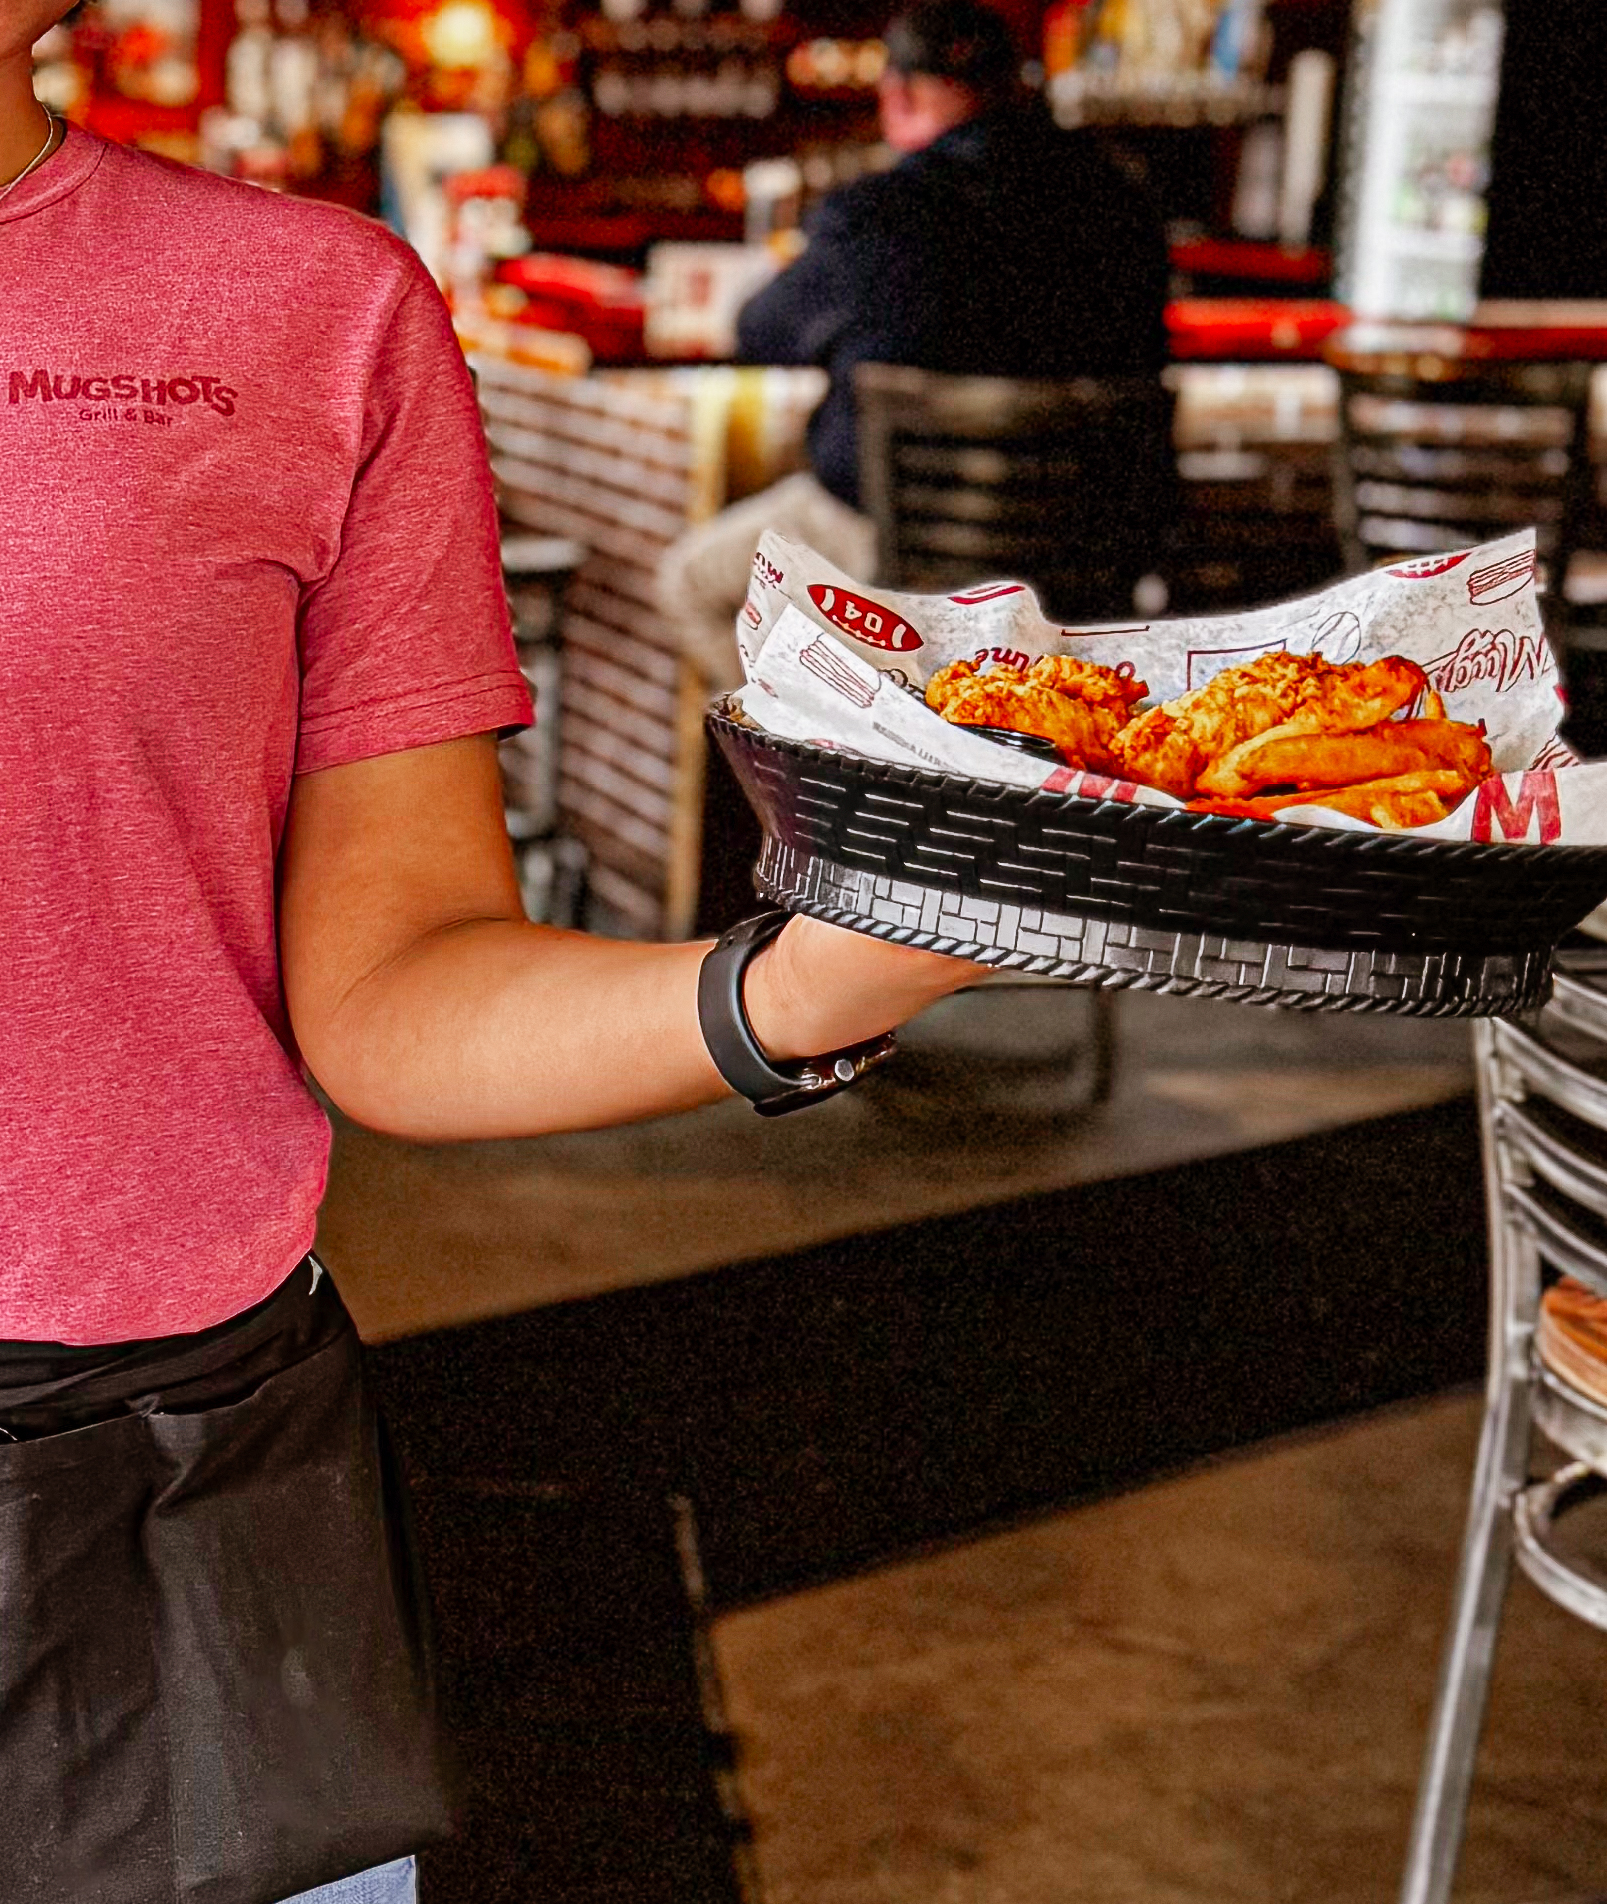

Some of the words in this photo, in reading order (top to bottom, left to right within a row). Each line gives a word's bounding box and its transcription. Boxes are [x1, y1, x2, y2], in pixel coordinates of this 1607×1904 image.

[8, 369, 238, 417] MUGSHOTS
[79, 408, 117, 422] Grill
[124, 409, 138, 422] &
[143, 409, 174, 427] Bar
